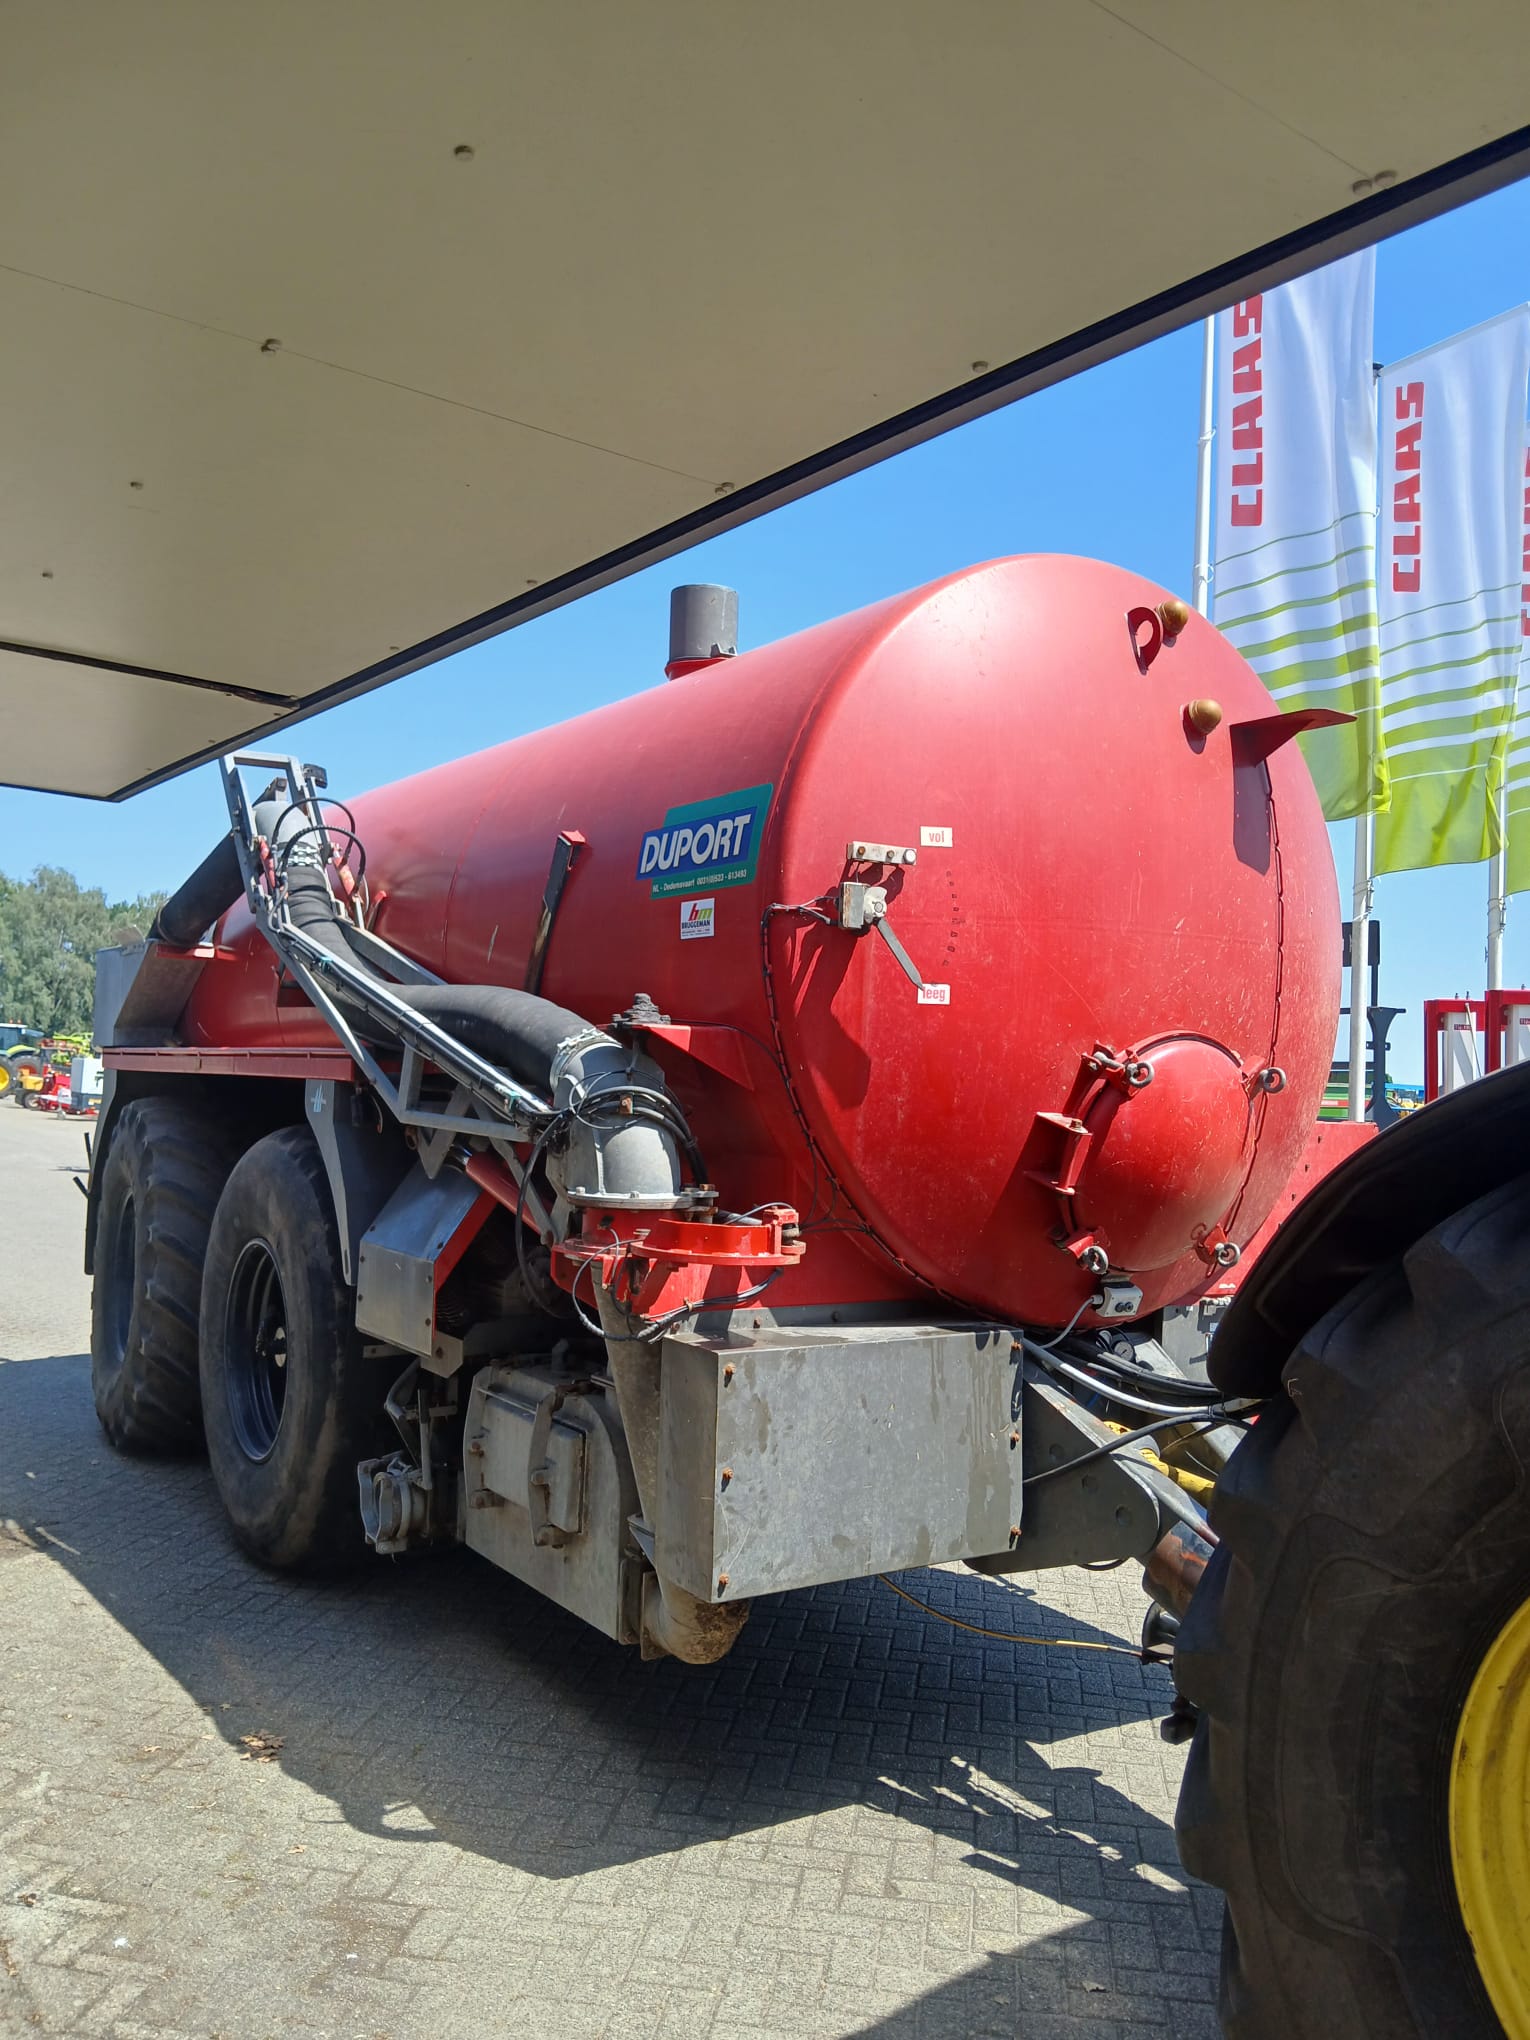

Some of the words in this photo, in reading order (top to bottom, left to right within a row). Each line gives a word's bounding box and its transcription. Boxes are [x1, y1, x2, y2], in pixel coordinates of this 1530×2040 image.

[1231, 293, 1263, 527] CLAAS
[1393, 381, 1425, 593] CLAAS
[640, 814, 752, 874] DUPORT
[929, 830, 945, 843] vol
[922, 986, 946, 1002] leeg
